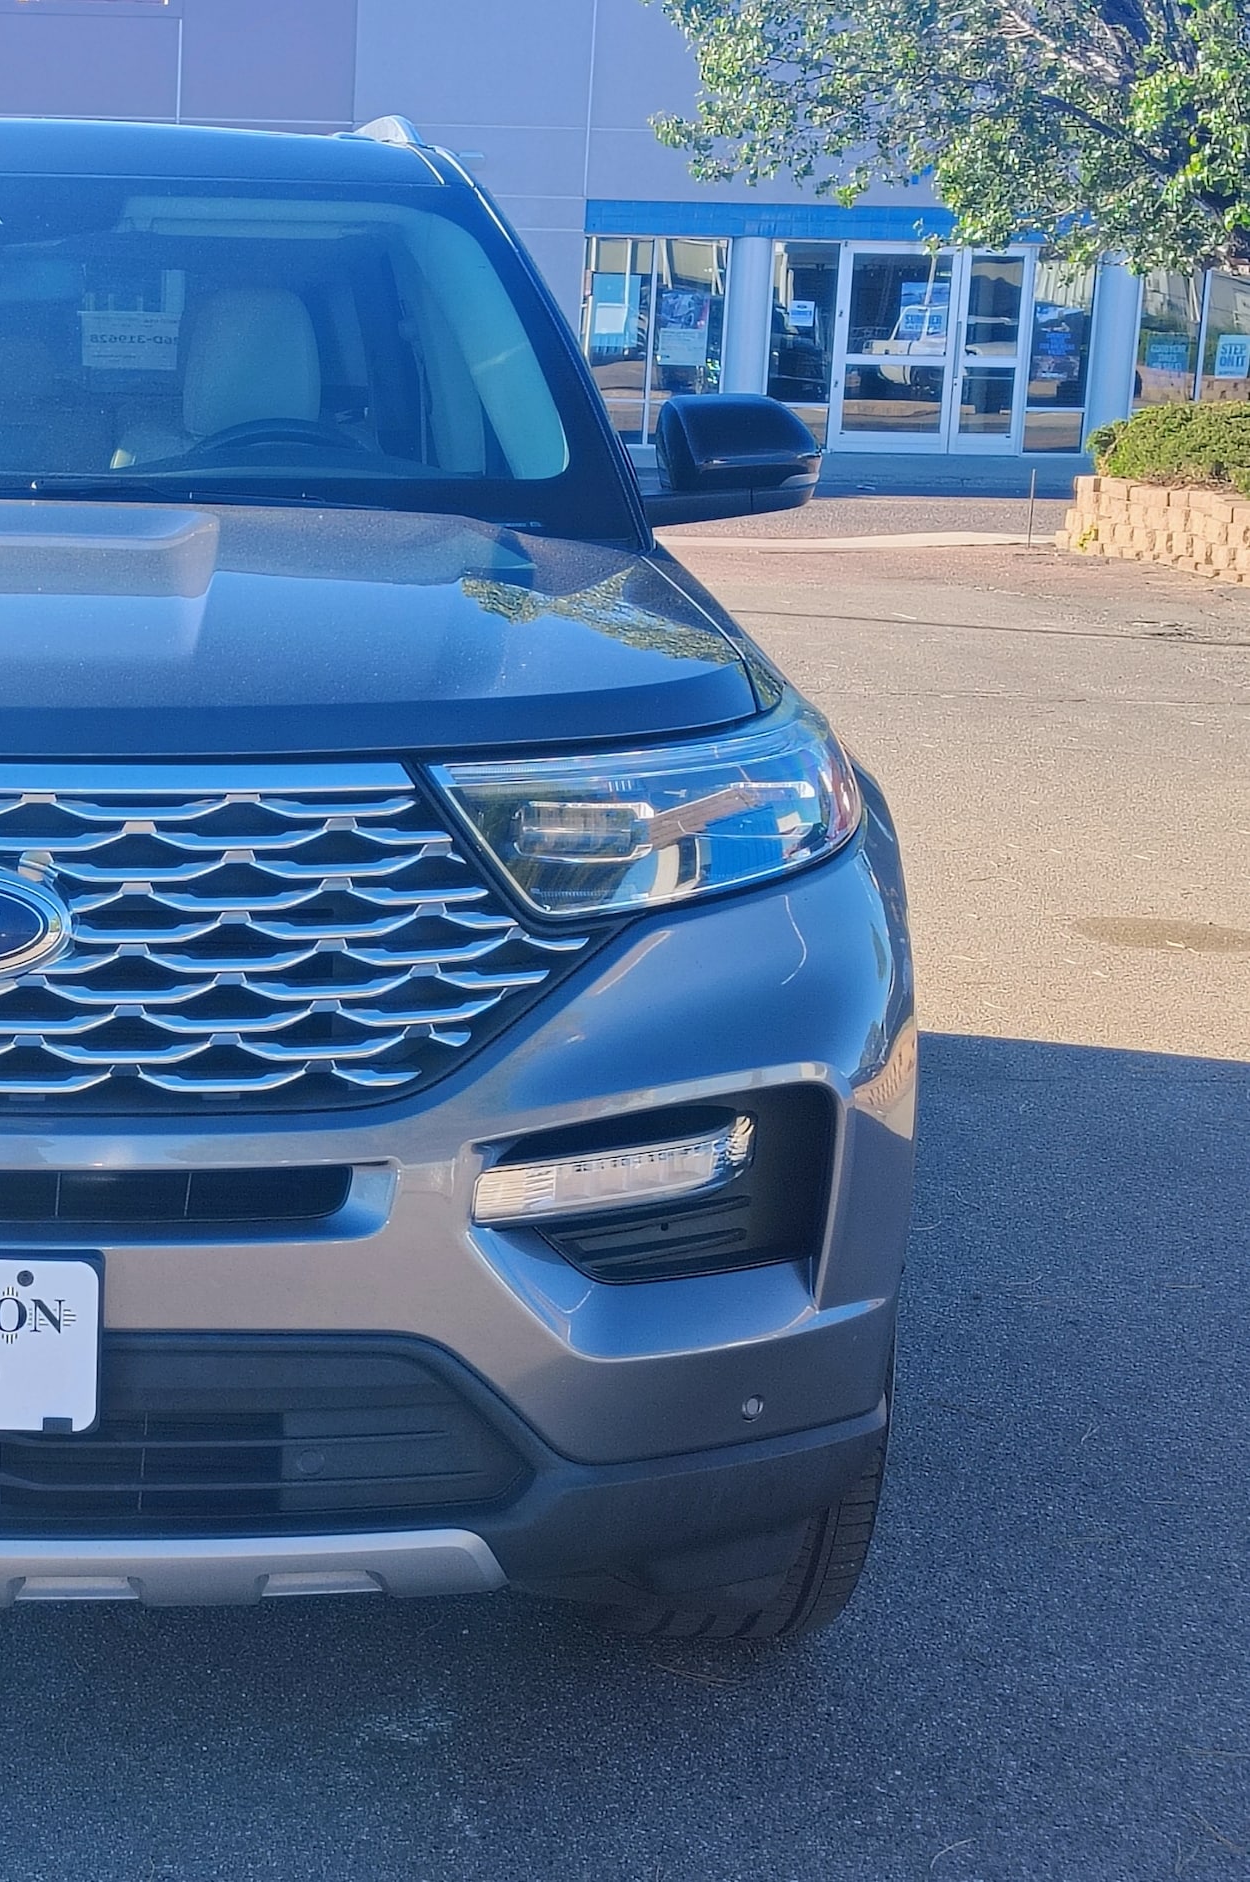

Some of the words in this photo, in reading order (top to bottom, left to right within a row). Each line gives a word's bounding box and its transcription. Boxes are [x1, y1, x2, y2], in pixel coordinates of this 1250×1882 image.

[1220, 343, 1247, 354] STEP
[1220, 356, 1235, 367] ON
[1236, 355, 1247, 367] IT
